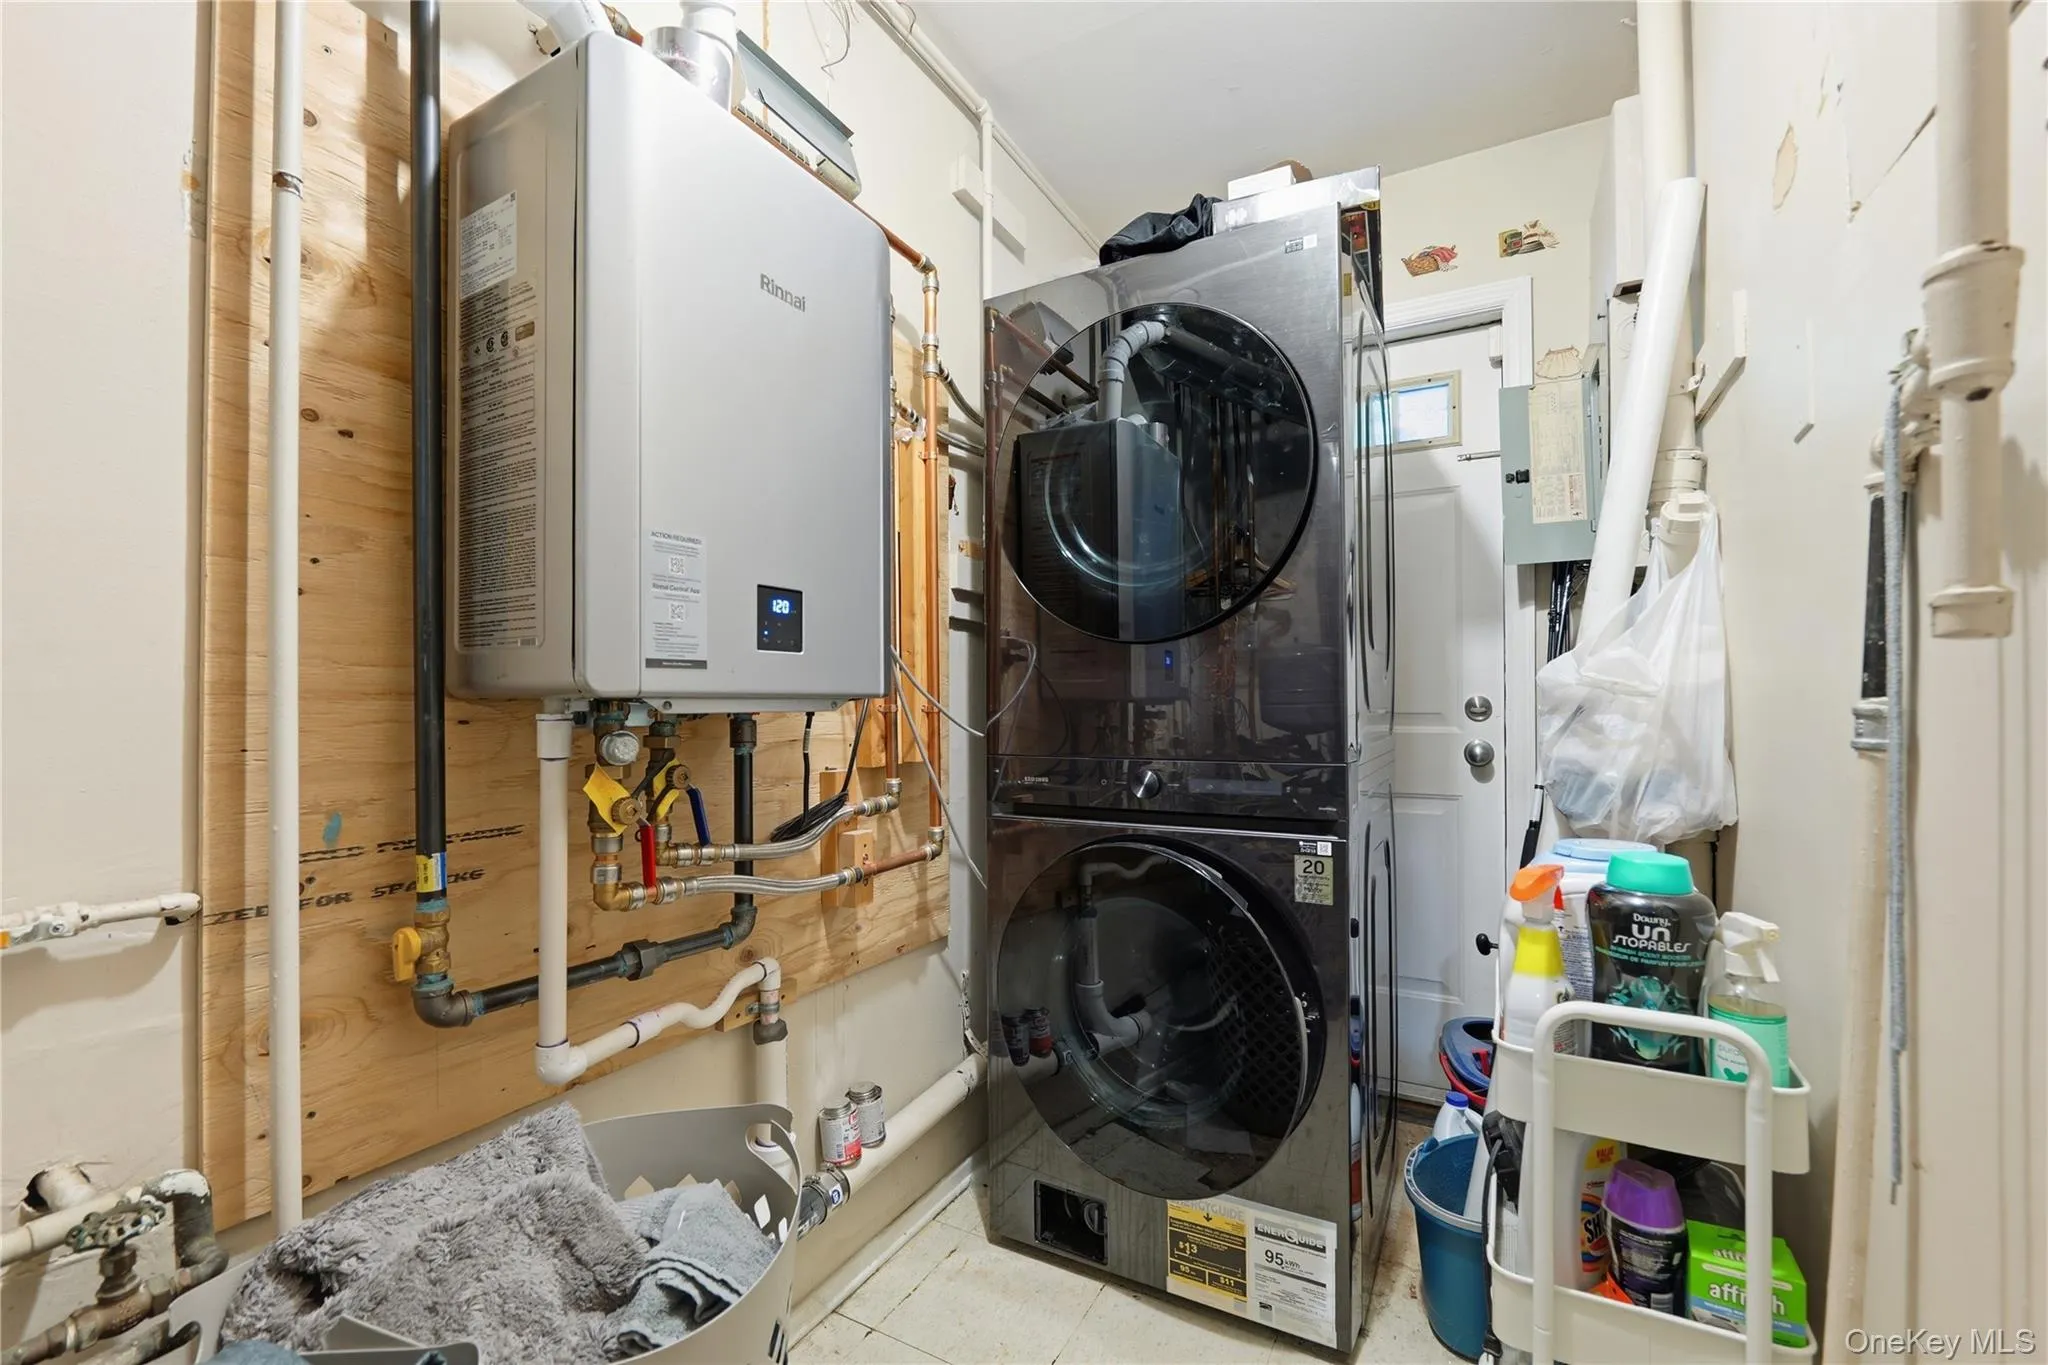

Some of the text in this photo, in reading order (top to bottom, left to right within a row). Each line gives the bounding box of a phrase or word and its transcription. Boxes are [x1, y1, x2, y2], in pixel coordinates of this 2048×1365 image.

[760, 273, 805, 312] Rinnai
[651, 531, 672, 540] ACTION
[772, 600, 790, 614] 120
[1303, 859, 1325, 875] 20
[300, 892, 352, 910] FOR
[1633, 913, 1669, 927] Downy
[1612, 935, 1692, 953] STOPABLES
[1179, 1241, 1198, 1254] $13
[1265, 1249, 1284, 1266] 95
